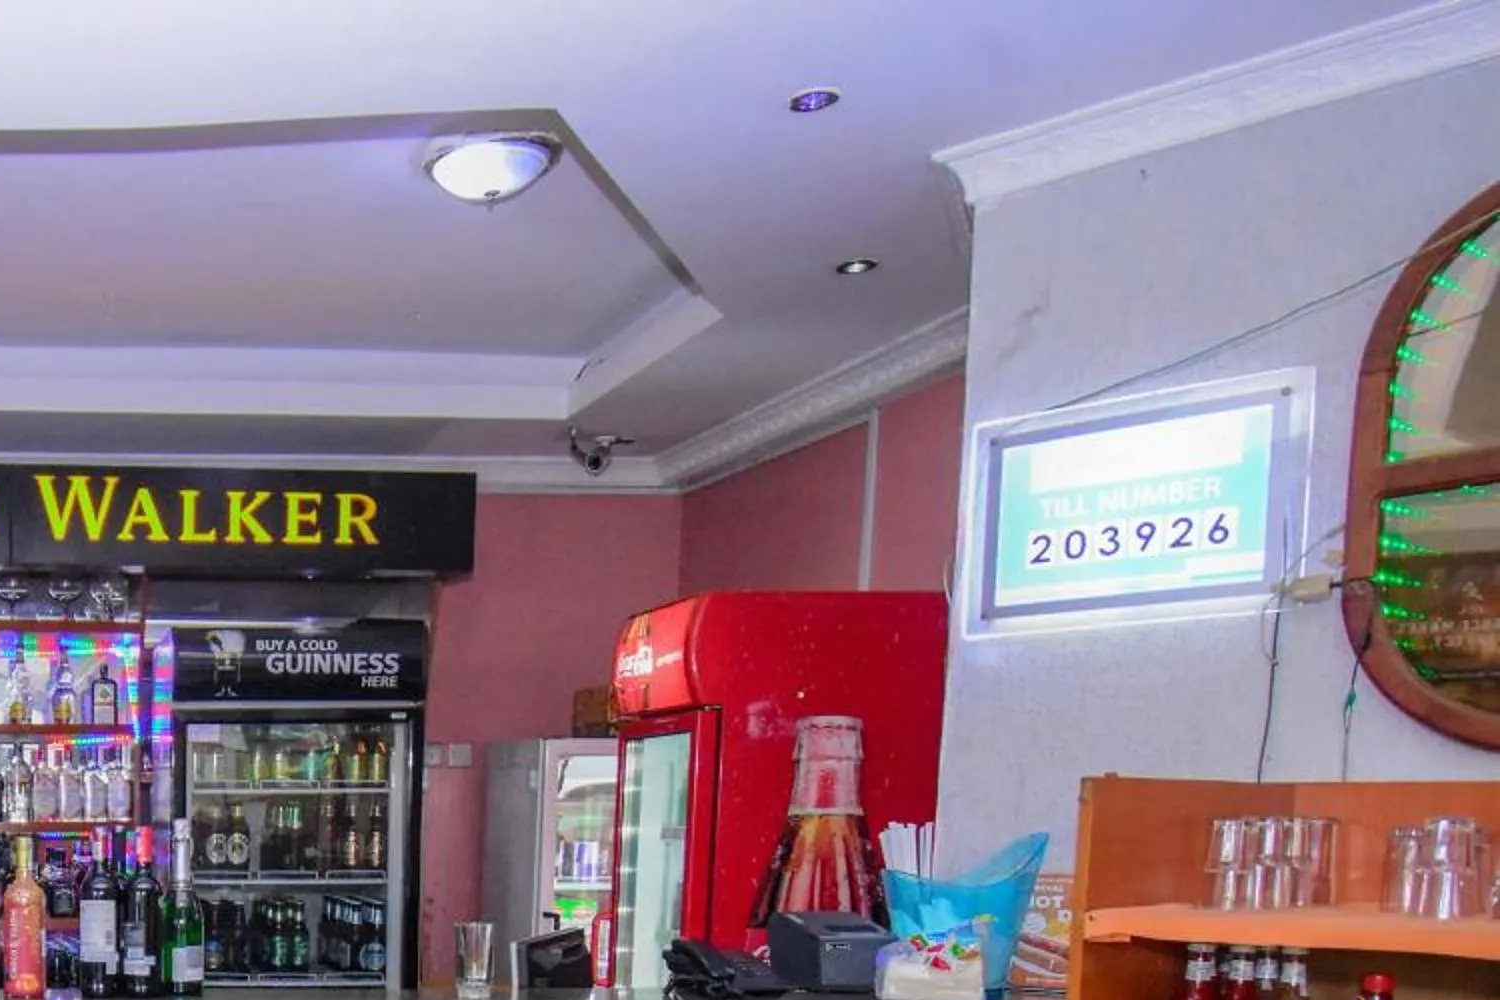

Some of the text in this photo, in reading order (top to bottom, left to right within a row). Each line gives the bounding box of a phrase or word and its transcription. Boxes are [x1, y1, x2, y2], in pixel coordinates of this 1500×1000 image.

[34, 474, 379, 546] WALKER
[1040, 476, 1221, 518] TILL NUMBER
[1029, 513, 1230, 565] 203926
[256, 639, 338, 651] BUY A COLD
[265, 653, 399, 675] GUINNESS
[361, 676, 398, 688] HERE
